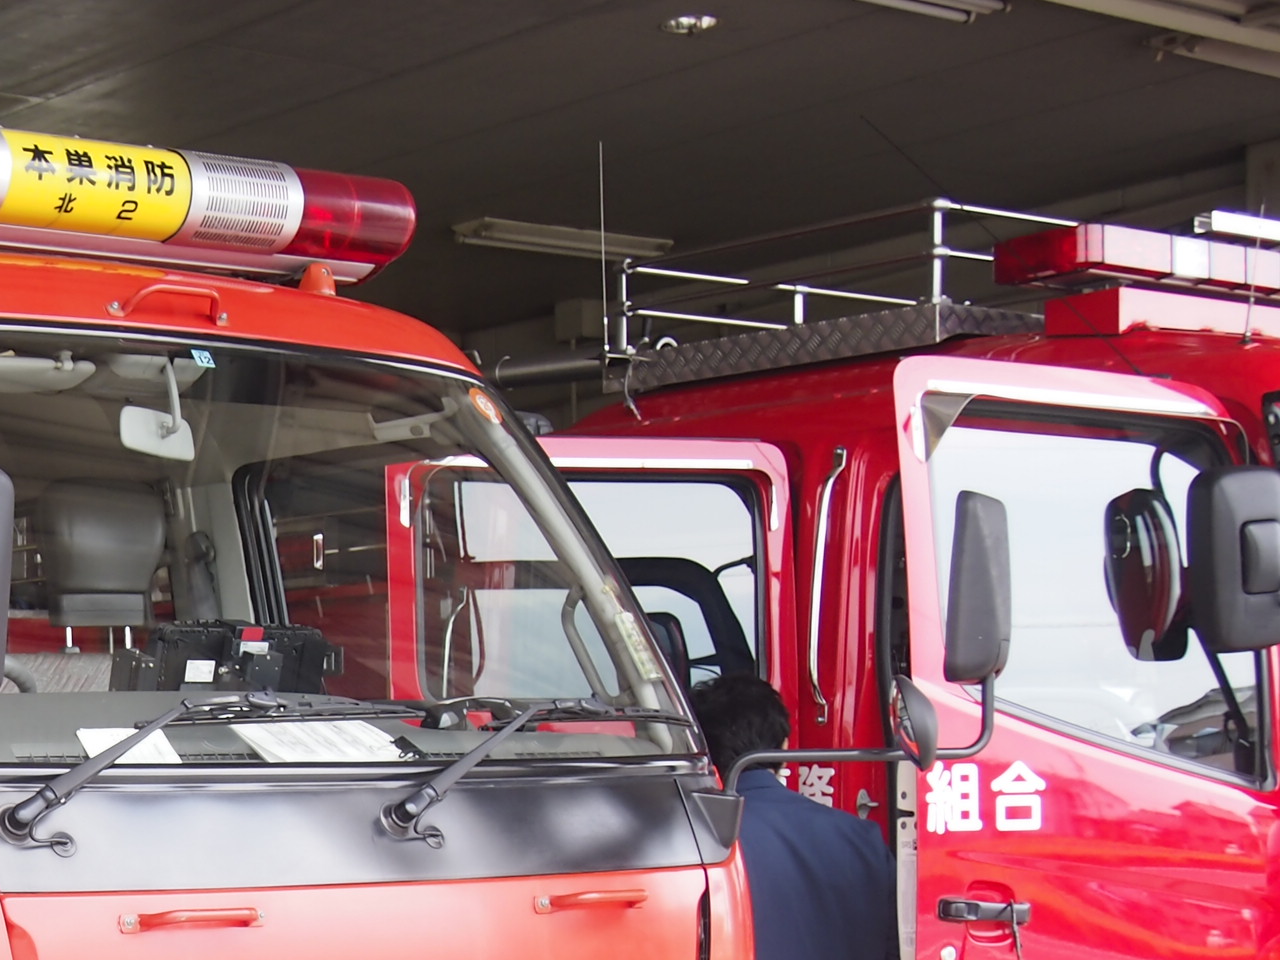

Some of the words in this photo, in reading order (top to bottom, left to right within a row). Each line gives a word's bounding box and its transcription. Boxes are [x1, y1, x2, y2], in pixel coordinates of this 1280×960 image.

[22, 144, 175, 197] 本巣消防
[54, 193, 77, 214] 北
[116, 200, 138, 220] 2
[925, 760, 1047, 835] 組合
